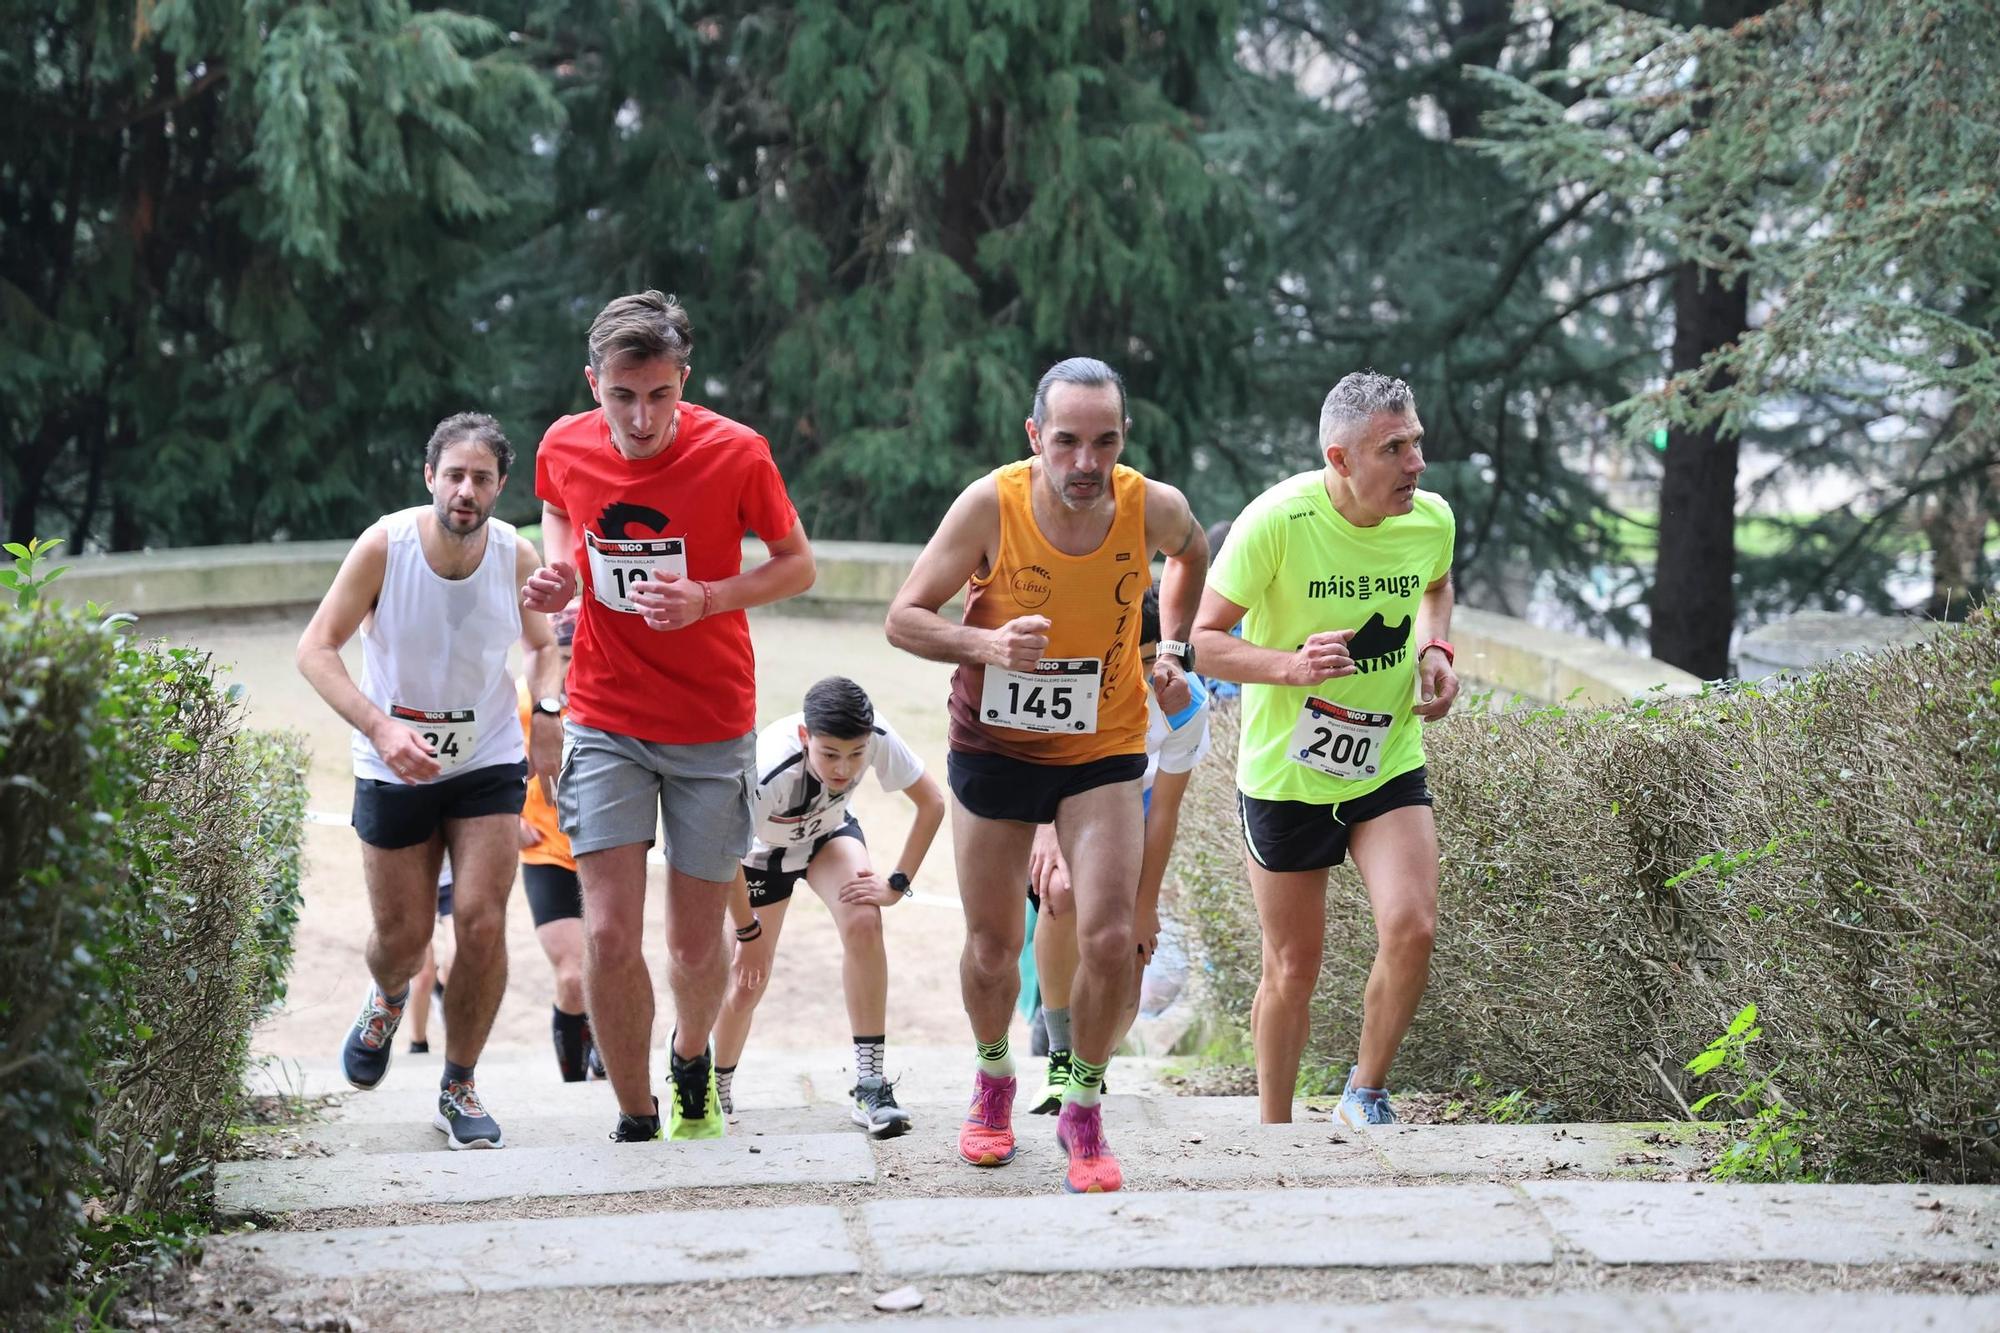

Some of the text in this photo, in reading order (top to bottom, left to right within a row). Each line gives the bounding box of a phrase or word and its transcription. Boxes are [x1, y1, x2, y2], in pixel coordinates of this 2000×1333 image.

[1014, 579, 1048, 593] Cibus
[1308, 575, 1420, 600] máis que auga
[1008, 682, 1072, 720] 145
[1308, 727, 1371, 768] 200
[789, 819, 822, 841] 32
